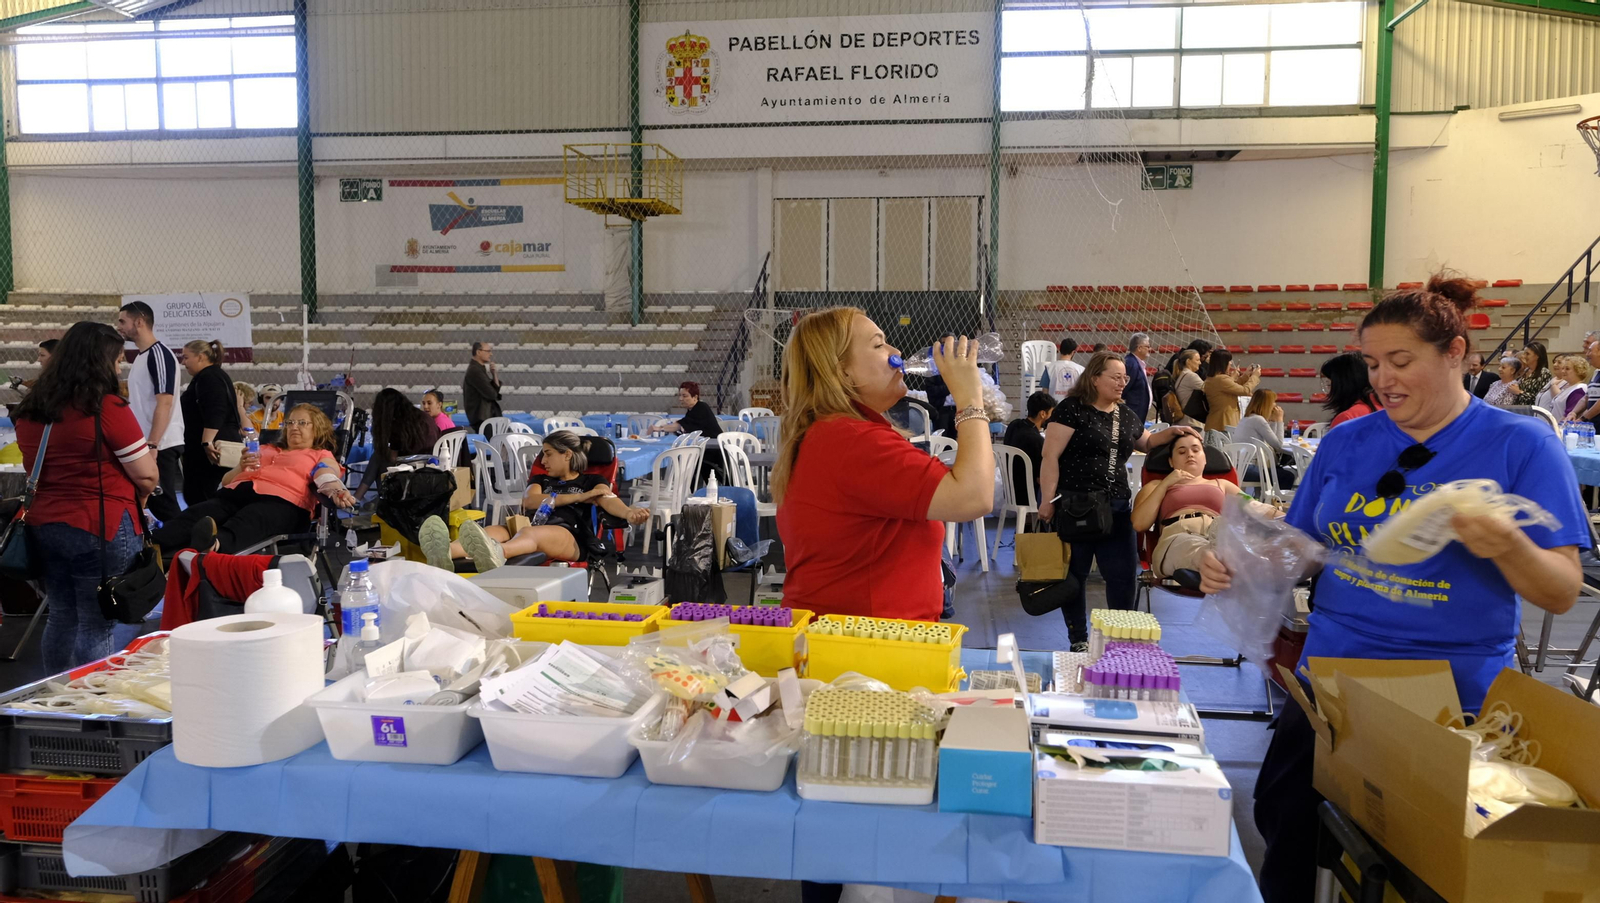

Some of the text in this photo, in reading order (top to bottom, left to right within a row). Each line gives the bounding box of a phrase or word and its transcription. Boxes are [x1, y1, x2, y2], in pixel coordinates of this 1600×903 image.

[728, 30, 980, 52] PABELLÓN DE DEPORTES
[766, 63, 940, 83] RAFAEL FLORIDO
[760, 93, 951, 108] Ayuntamiento de Almería
[1169, 167, 1191, 175] FONDO
[362, 181, 381, 189] FONDO
[1174, 175, 1186, 187] A
[367, 188, 377, 199] A
[494, 239, 551, 256] cajamar
[166, 302, 192, 310] GRUPO
[163, 310, 212, 318] DELICATESSEN
[1344, 492, 1412, 517] DON
[1375, 570, 1451, 589] de donación de
[1391, 586, 1403, 596] de
[380, 722, 398, 734] 6L
